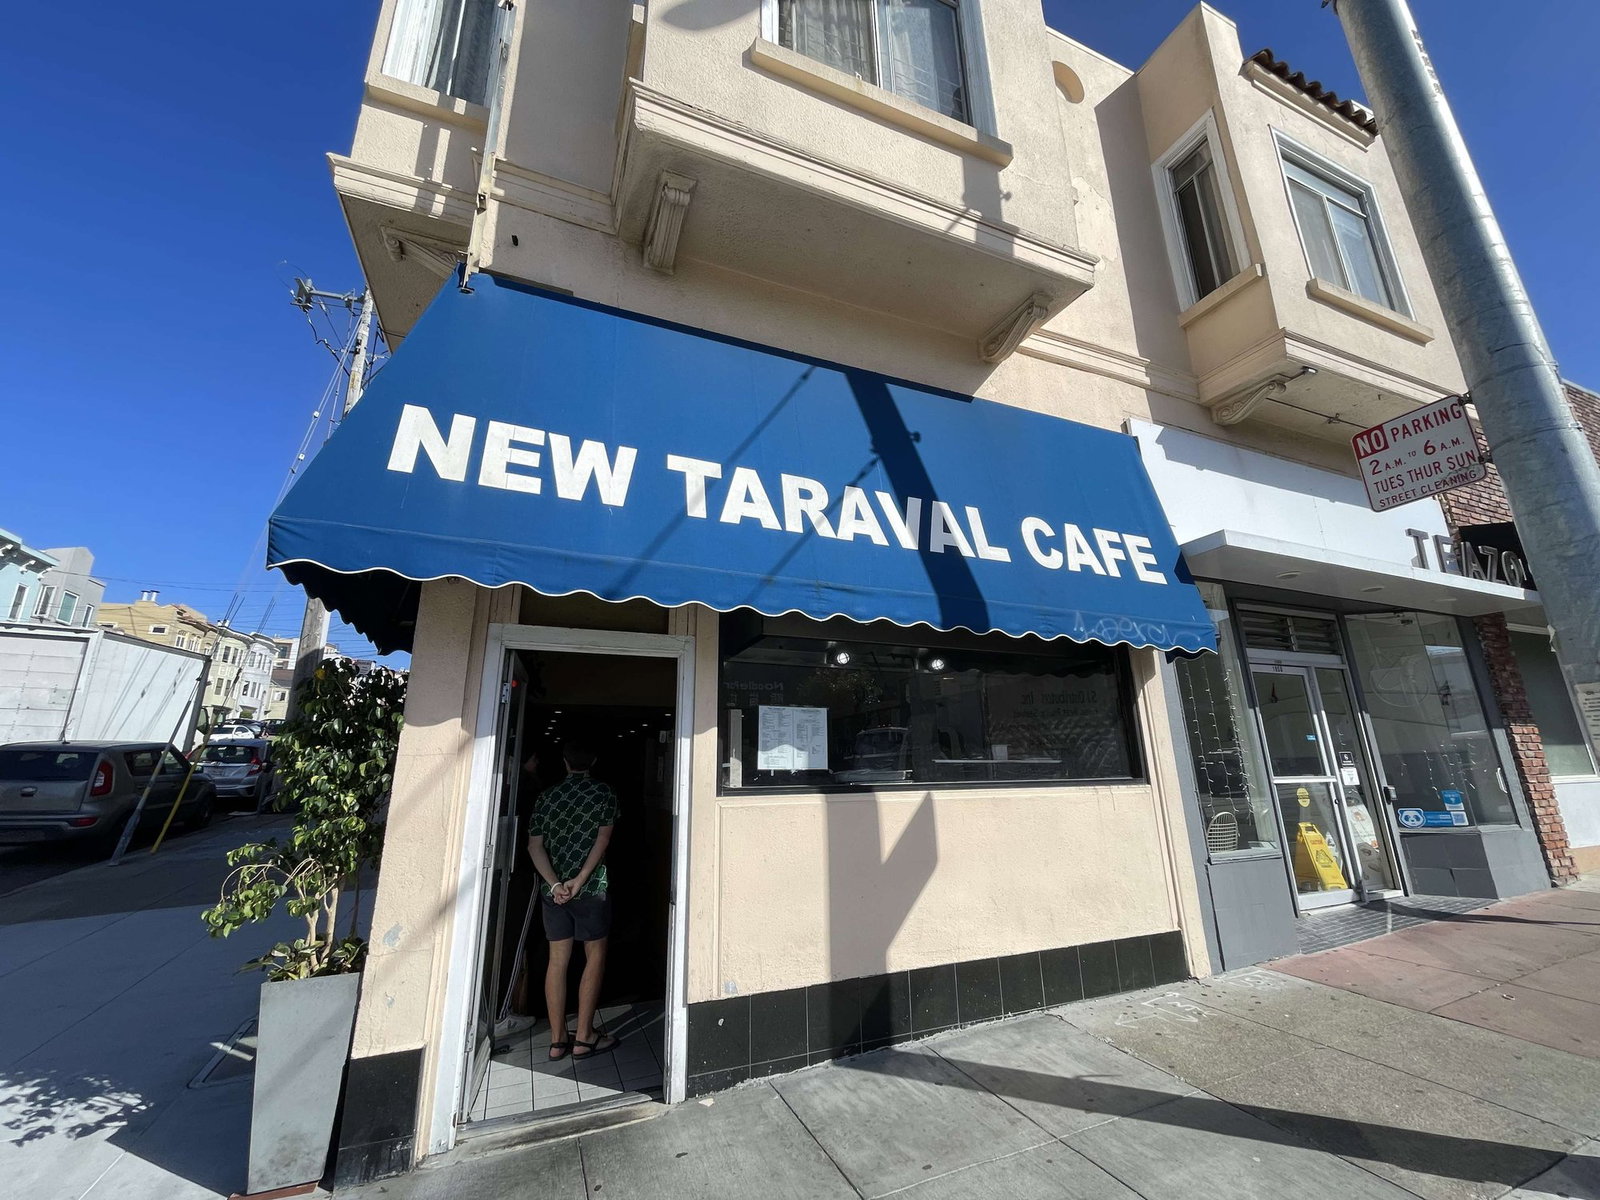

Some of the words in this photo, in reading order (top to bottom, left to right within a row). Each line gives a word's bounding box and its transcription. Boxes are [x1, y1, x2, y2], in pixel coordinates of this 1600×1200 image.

[1356, 429, 1385, 458] NO
[1390, 403, 1462, 442] PARKING
[1369, 460, 1382, 475] 2
[1385, 457, 1406, 471] A.M.
[1423, 440, 1436, 455] 6
[1440, 437, 1465, 451] A.M.
[1373, 474, 1405, 494] TUES
[1407, 461, 1443, 483] THUR
[1446, 449, 1477, 470] SUN
[387, 404, 637, 507] NEW
[666, 454, 1012, 563] TARAVAL
[1020, 516, 1168, 585] CAFE
[1380, 490, 1416, 507] STREET
[1420, 469, 1477, 494] CLEANING
